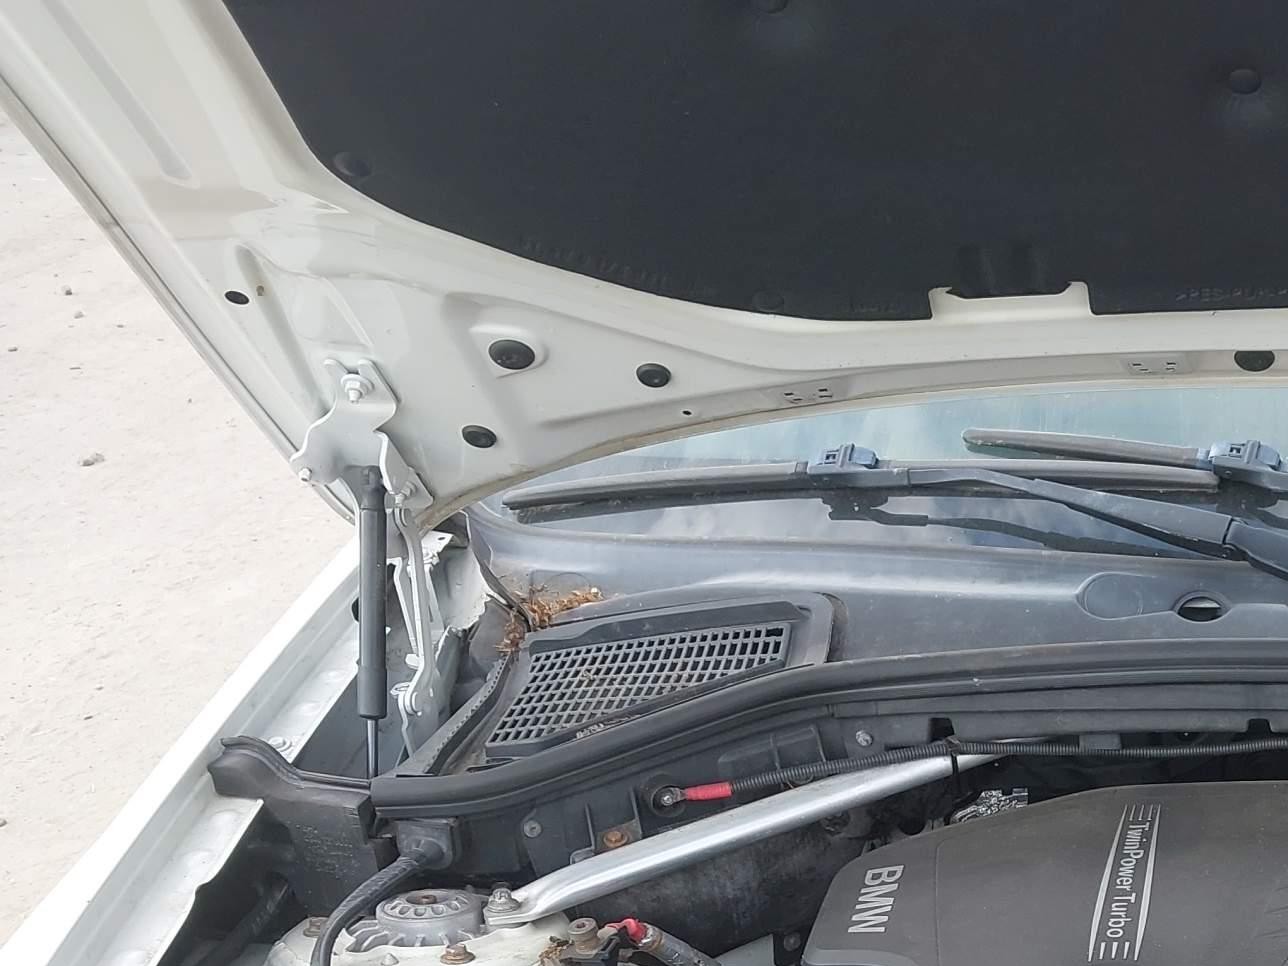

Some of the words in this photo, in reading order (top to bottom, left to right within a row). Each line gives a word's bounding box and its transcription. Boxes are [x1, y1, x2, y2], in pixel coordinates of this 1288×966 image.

[1115, 822, 1150, 891] TwinPower
[847, 865, 904, 933] BMW
[1106, 892, 1137, 938] Turbo
